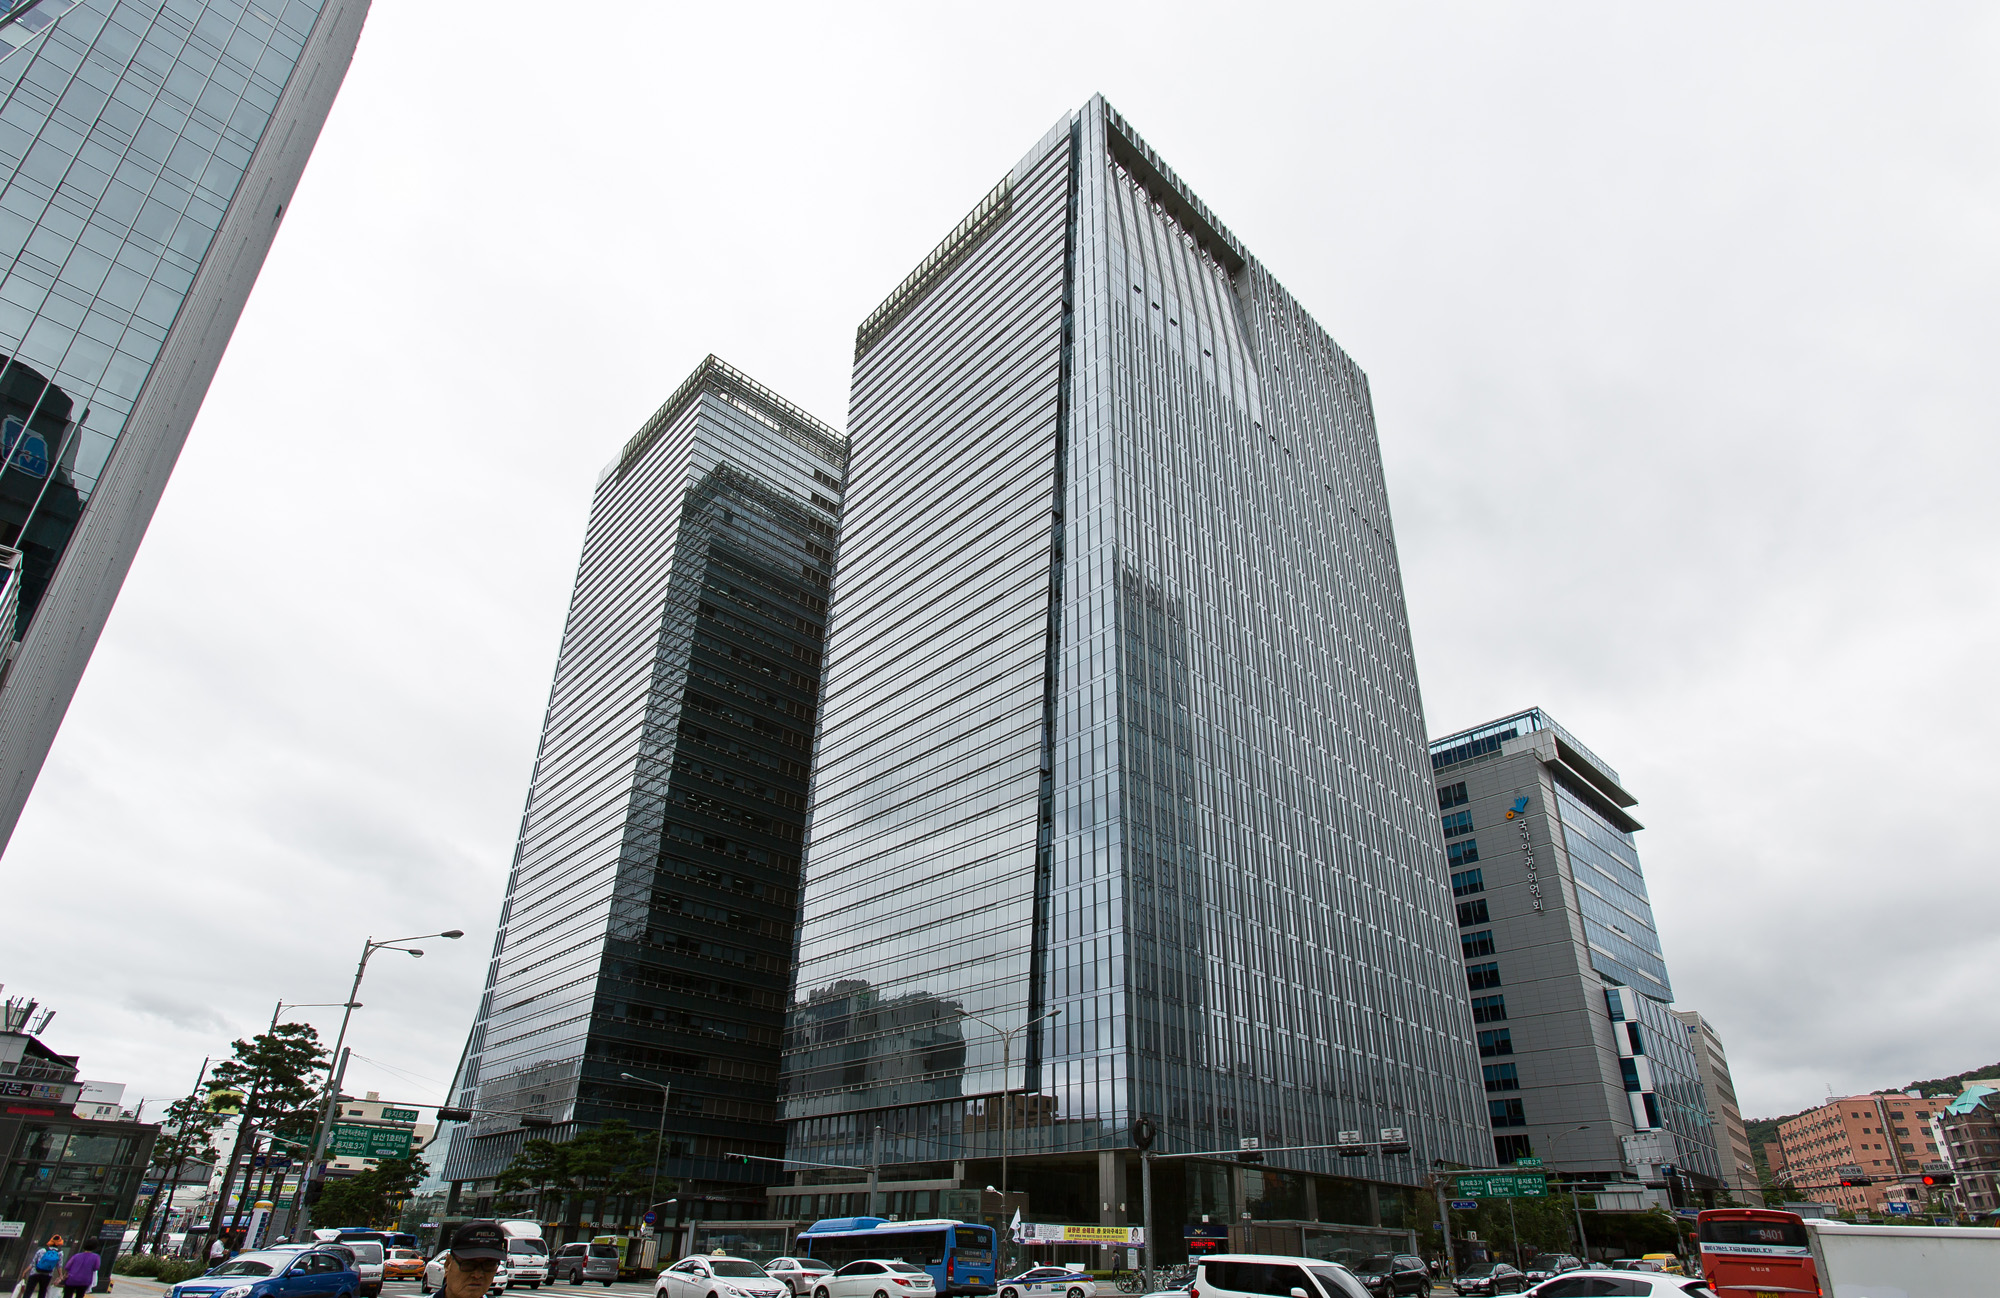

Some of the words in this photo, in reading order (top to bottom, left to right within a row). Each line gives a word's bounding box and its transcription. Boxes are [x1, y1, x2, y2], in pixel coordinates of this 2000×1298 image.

[1519, 819, 1543, 910] 국가인권위원회
[384, 1109, 417, 1119] 을지로2가
[372, 1132, 408, 1143] 남산1호터널
[336, 1141, 366, 1150] 을지로3가
[1517, 1177, 1542, 1185] 을지로1가
[977, 1235, 987, 1243] 100
[1760, 1229, 1783, 1240] 9401
